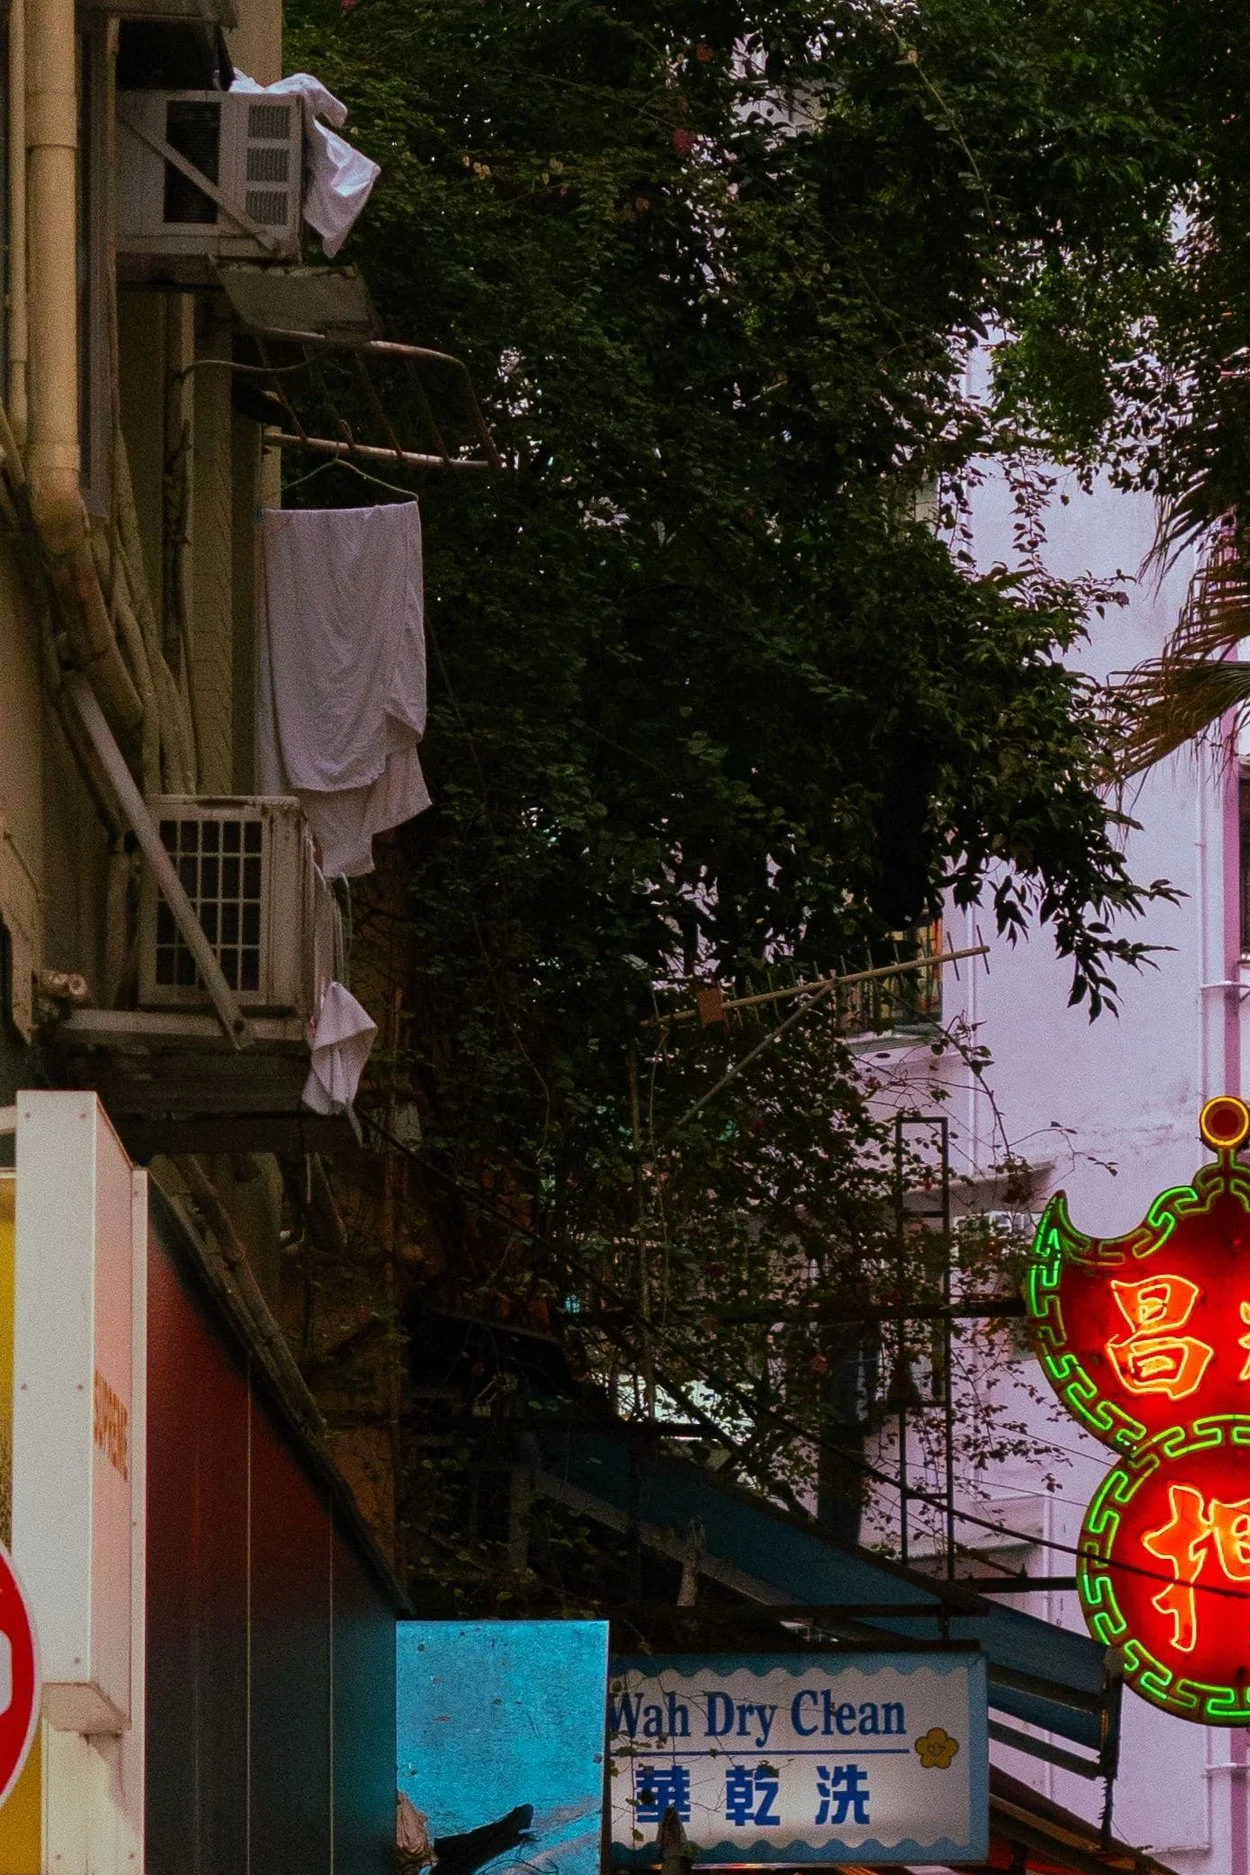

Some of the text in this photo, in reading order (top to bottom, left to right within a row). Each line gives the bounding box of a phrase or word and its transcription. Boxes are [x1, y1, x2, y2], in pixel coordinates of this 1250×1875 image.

[607, 1689, 907, 1749] Wah Dry Clean
[635, 1763, 871, 1827] 華乾洗
